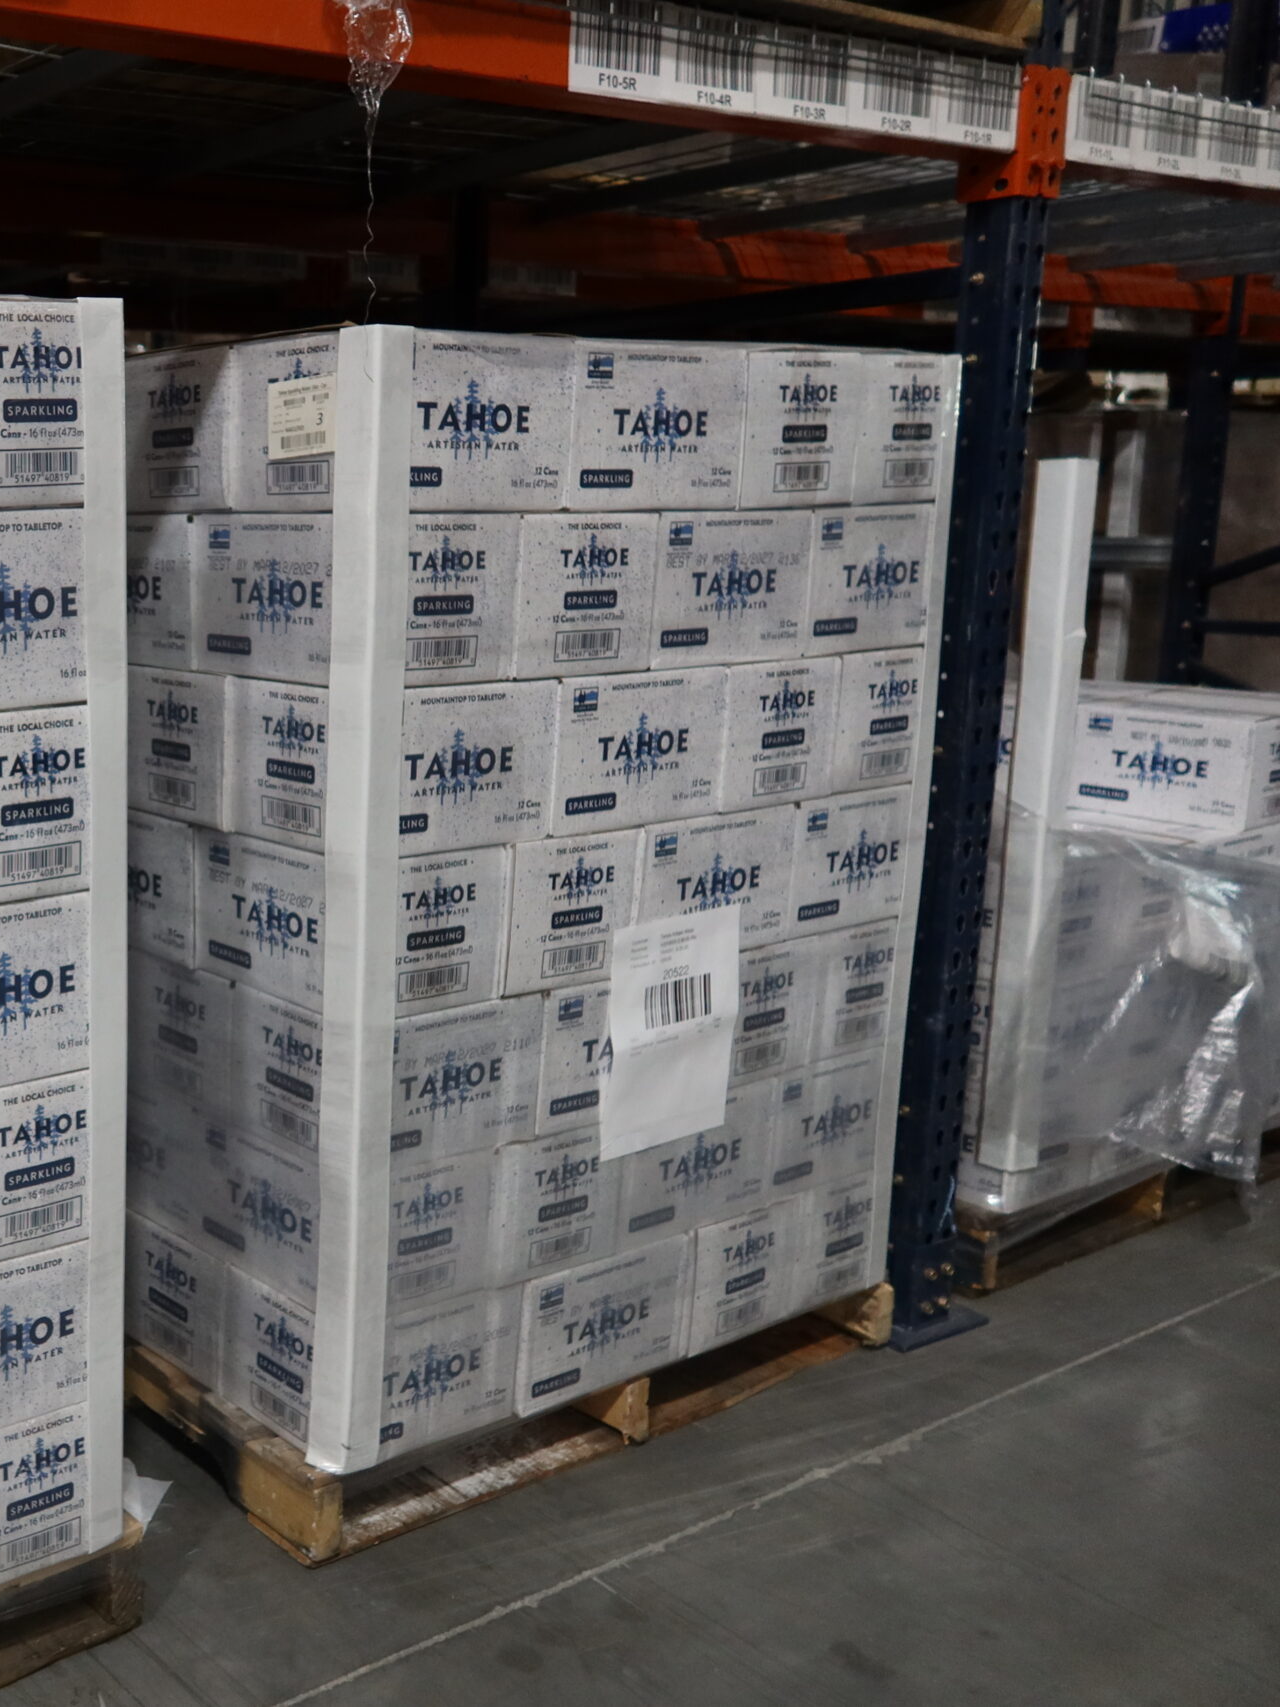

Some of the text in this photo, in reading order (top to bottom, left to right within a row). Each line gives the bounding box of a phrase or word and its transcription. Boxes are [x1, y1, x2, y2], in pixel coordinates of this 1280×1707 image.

[599, 73, 636, 91] F10-5R
[697, 91, 732, 107] F10-4R
[793, 105, 825, 120] F10-3R
[881, 117, 911, 132] F10-2R
[963, 130, 992, 145] F10-1R
[780, 385, 838, 403] TAHOE
[890, 385, 941, 403] TAHOE
[7, 405, 74, 416] SPARKLING
[417, 402, 530, 433] TAHOE
[614, 409, 708, 437] TAHOE
[427, 439, 519, 451] ARTESIAN WATER
[583, 474, 630, 484] SPARKLING
[409, 550, 485, 571] TAHOE
[560, 548, 629, 568] TAHOE
[232, 578, 323, 608] TAHOE
[692, 569, 776, 597] TAHOE
[417, 601, 470, 611] SPARKLING
[567, 595, 614, 606] SPARKLING
[663, 632, 706, 644] SPARKLING
[760, 690, 815, 712] TAHOE
[262, 716, 325, 743] TAHOE
[598, 728, 689, 761] TAHOE
[405, 746, 513, 780] TAHOE
[1112, 749, 1208, 778] TAHOE
[5, 803, 70, 821] SPARKLING
[568, 798, 614, 811] SPARKLING
[827, 840, 900, 873] TAHOE
[549, 866, 614, 890] TAHOE
[677, 865, 761, 901] TAHOE
[403, 883, 476, 910] TAHOE
[232, 894, 318, 944] TAHOE
[555, 911, 600, 925] SPARKLING
[410, 931, 462, 946] SPARKLING
[663, 964, 690, 980] 20522
[400, 1057, 502, 1101] TAHOE
[563, 1298, 650, 1344] TAHOE
[254, 1312, 313, 1362] TAHOE
